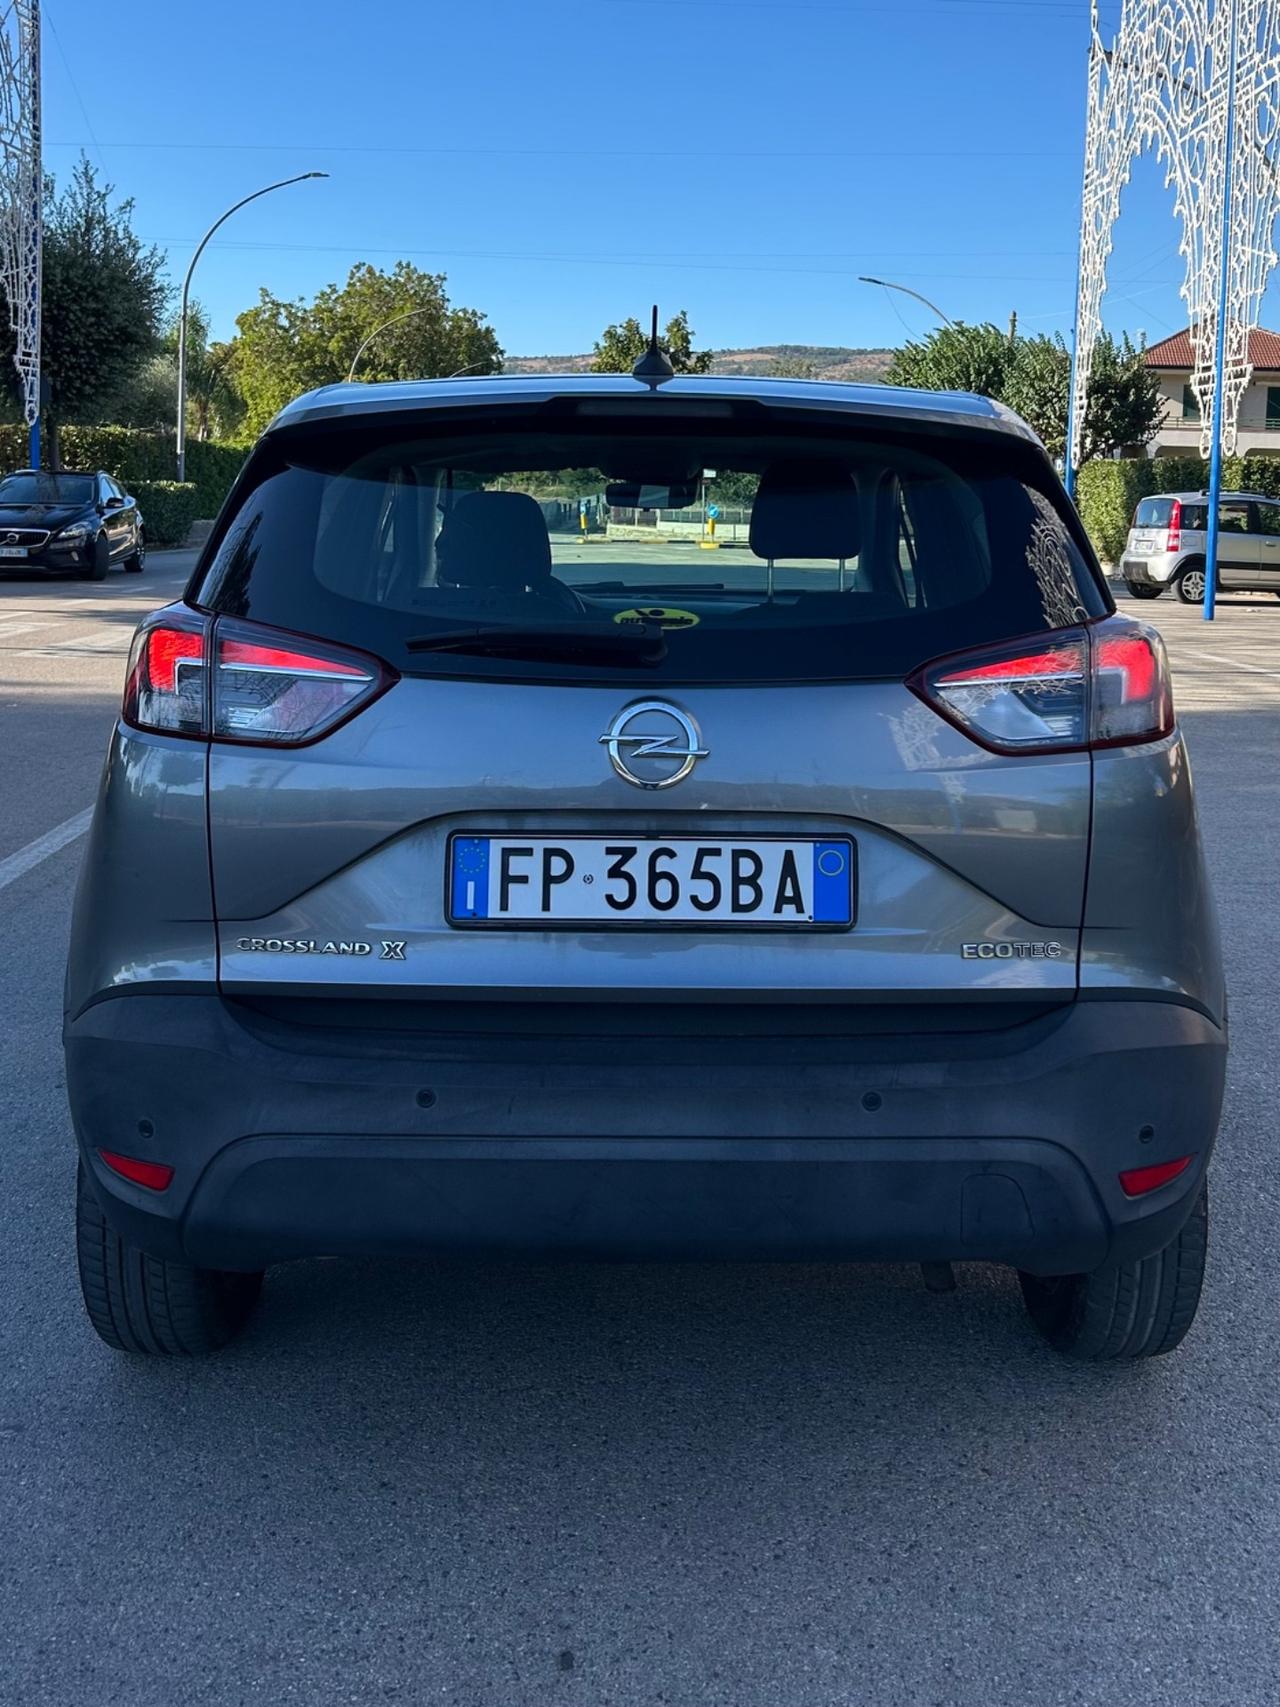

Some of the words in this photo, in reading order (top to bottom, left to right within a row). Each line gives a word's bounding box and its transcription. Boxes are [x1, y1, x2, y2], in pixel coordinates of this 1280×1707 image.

[499, 847, 574, 912] FP
[605, 847, 804, 914] 365BA
[236, 937, 371, 956] CROSSLAND
[380, 940, 408, 960] X
[961, 942, 1061, 960] ECOTEC
